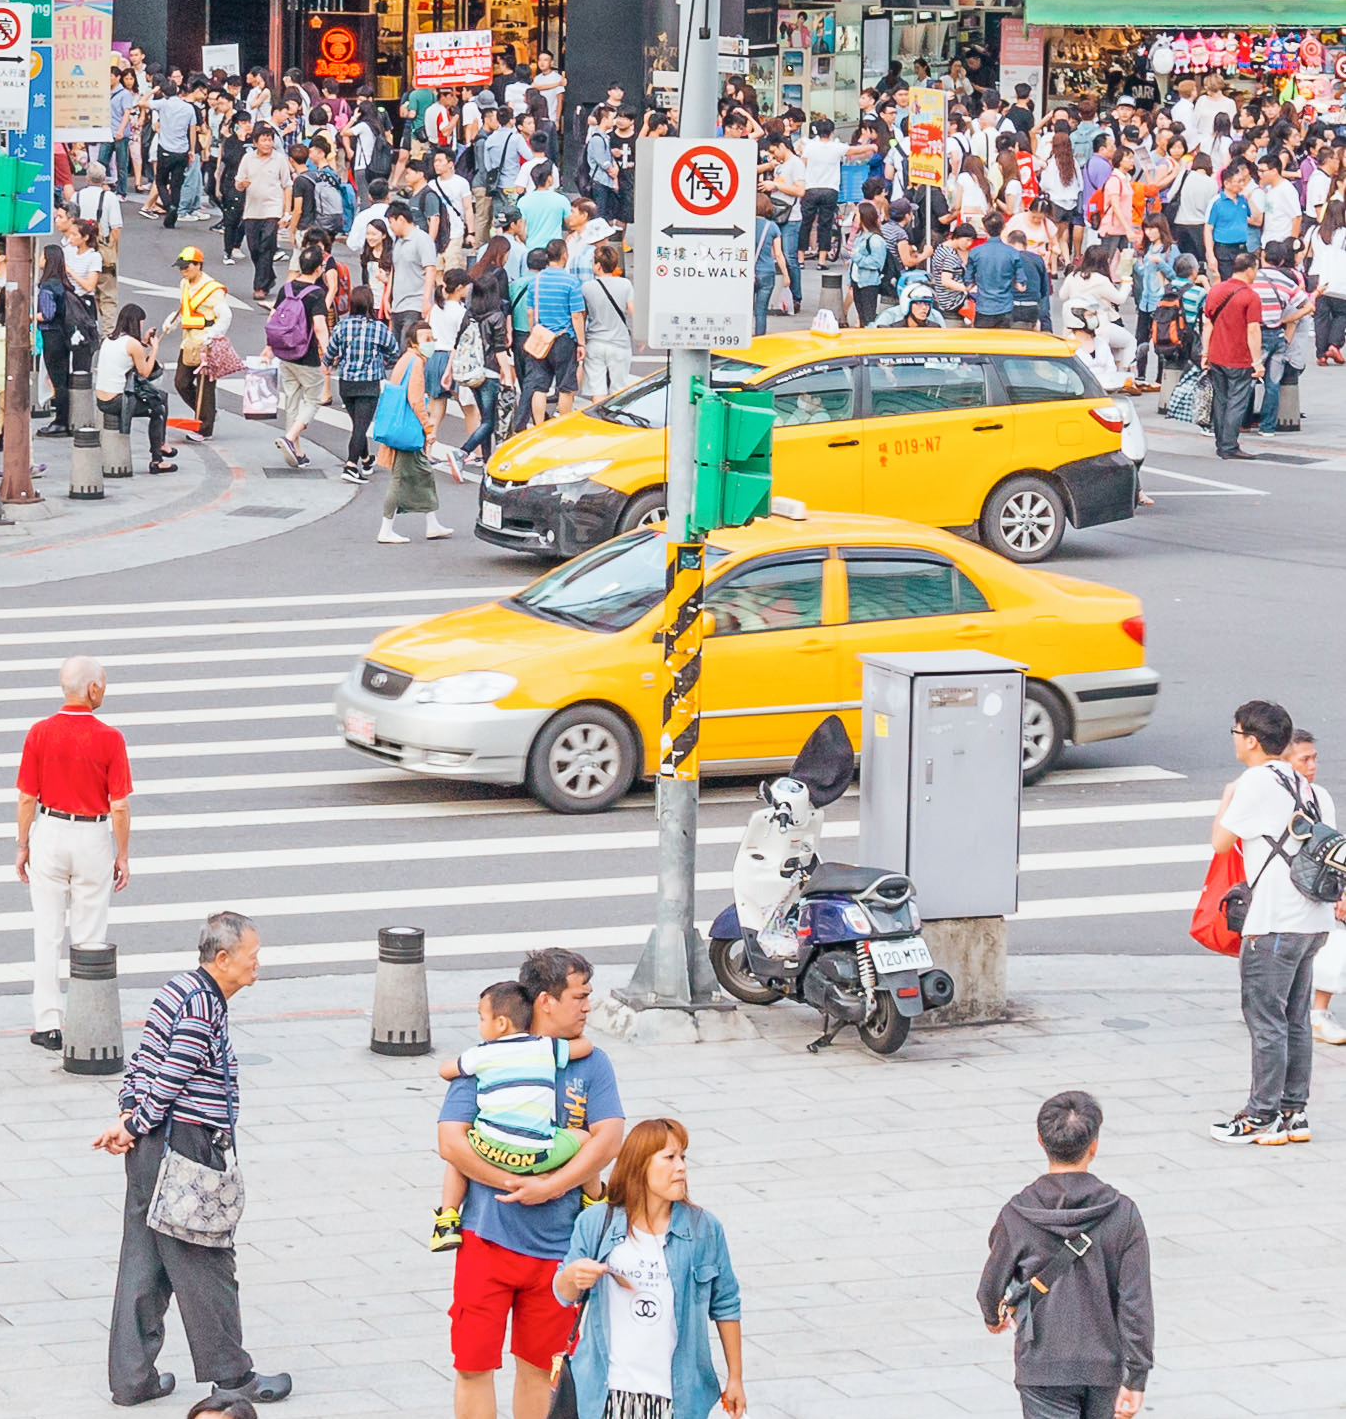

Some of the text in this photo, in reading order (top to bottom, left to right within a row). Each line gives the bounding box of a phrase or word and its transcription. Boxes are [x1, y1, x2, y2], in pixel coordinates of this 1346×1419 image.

[685, 162, 723, 201] 停
[712, 335, 740, 346] 1999
[893, 436, 942, 456] 019-N7
